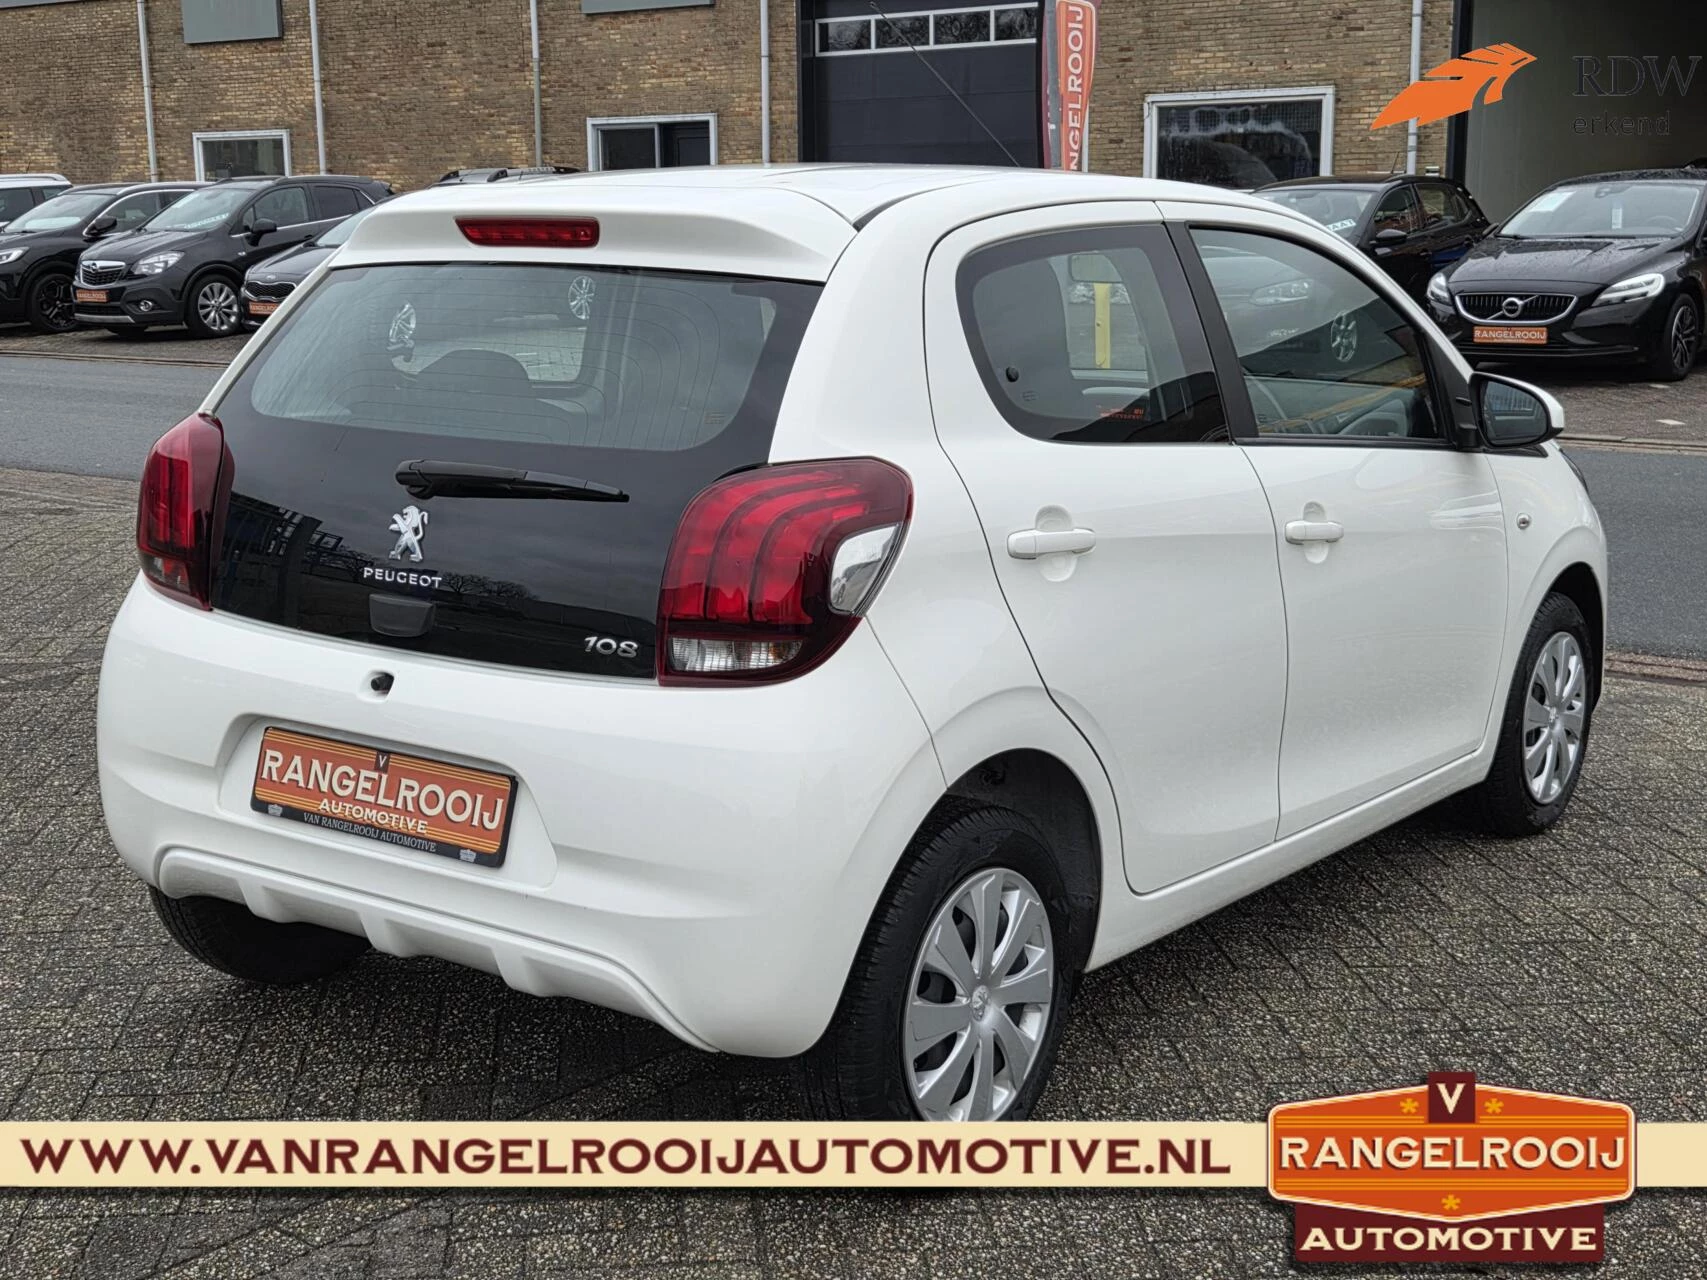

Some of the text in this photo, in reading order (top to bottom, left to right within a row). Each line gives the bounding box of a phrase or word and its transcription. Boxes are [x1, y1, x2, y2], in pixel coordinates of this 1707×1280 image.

[1474, 329, 1546, 340] RANGELROOIJ
[363, 566, 442, 588] PEUGEOT
[584, 636, 639, 658] 108
[378, 754, 388, 768] V
[260, 748, 505, 831] RANGELROOIJ
[317, 798, 428, 834] AUTOMOTIVE
[303, 812, 437, 852] VAN RANGELROOIJ AUTOMOTIVE
